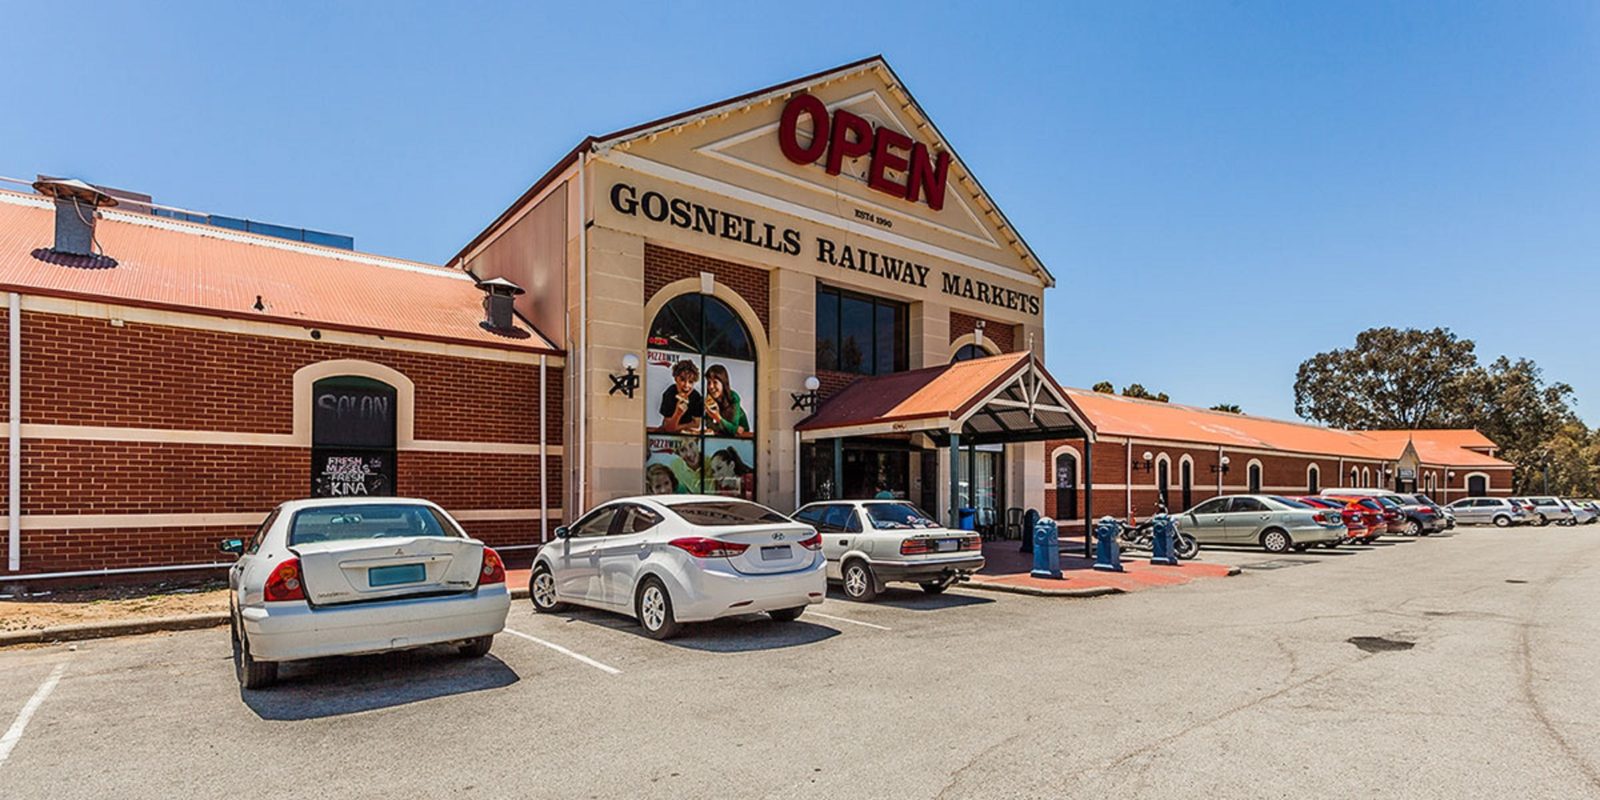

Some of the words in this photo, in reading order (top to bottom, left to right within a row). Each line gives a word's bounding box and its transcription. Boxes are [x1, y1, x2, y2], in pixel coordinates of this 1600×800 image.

[779, 93, 950, 211] OPEN
[610, 183, 801, 256] GOSNELLS
[816, 237, 929, 288] RAILWAY
[941, 271, 1040, 316] MARKETS
[331, 482, 368, 495] KINA
